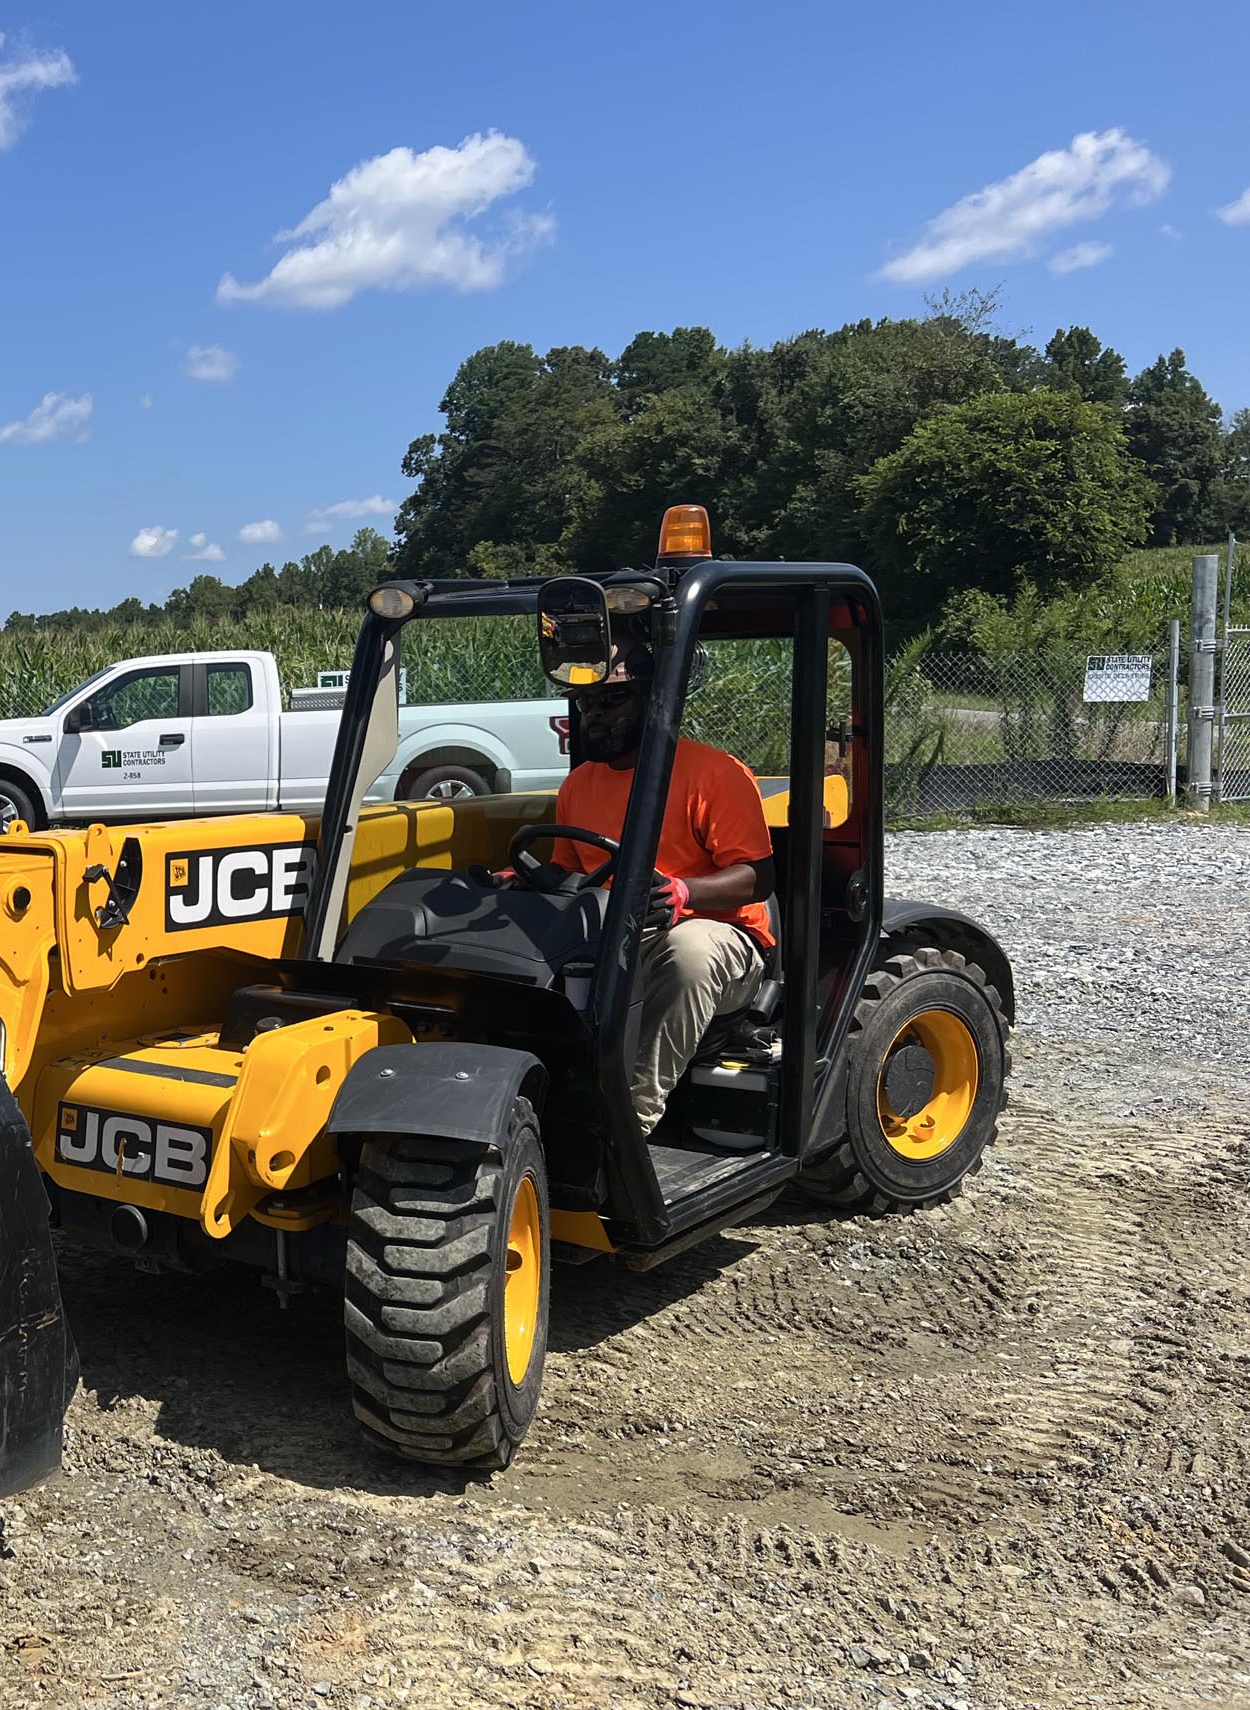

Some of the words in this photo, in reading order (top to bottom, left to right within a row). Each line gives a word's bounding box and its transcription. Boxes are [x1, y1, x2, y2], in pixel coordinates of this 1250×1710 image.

[123, 751, 141, 759] STATE
[142, 750, 165, 758] UTILITY
[123, 758, 166, 766] CONTRACTORS
[170, 848, 317, 924] JCB
[60, 1112, 207, 1185] JCB
